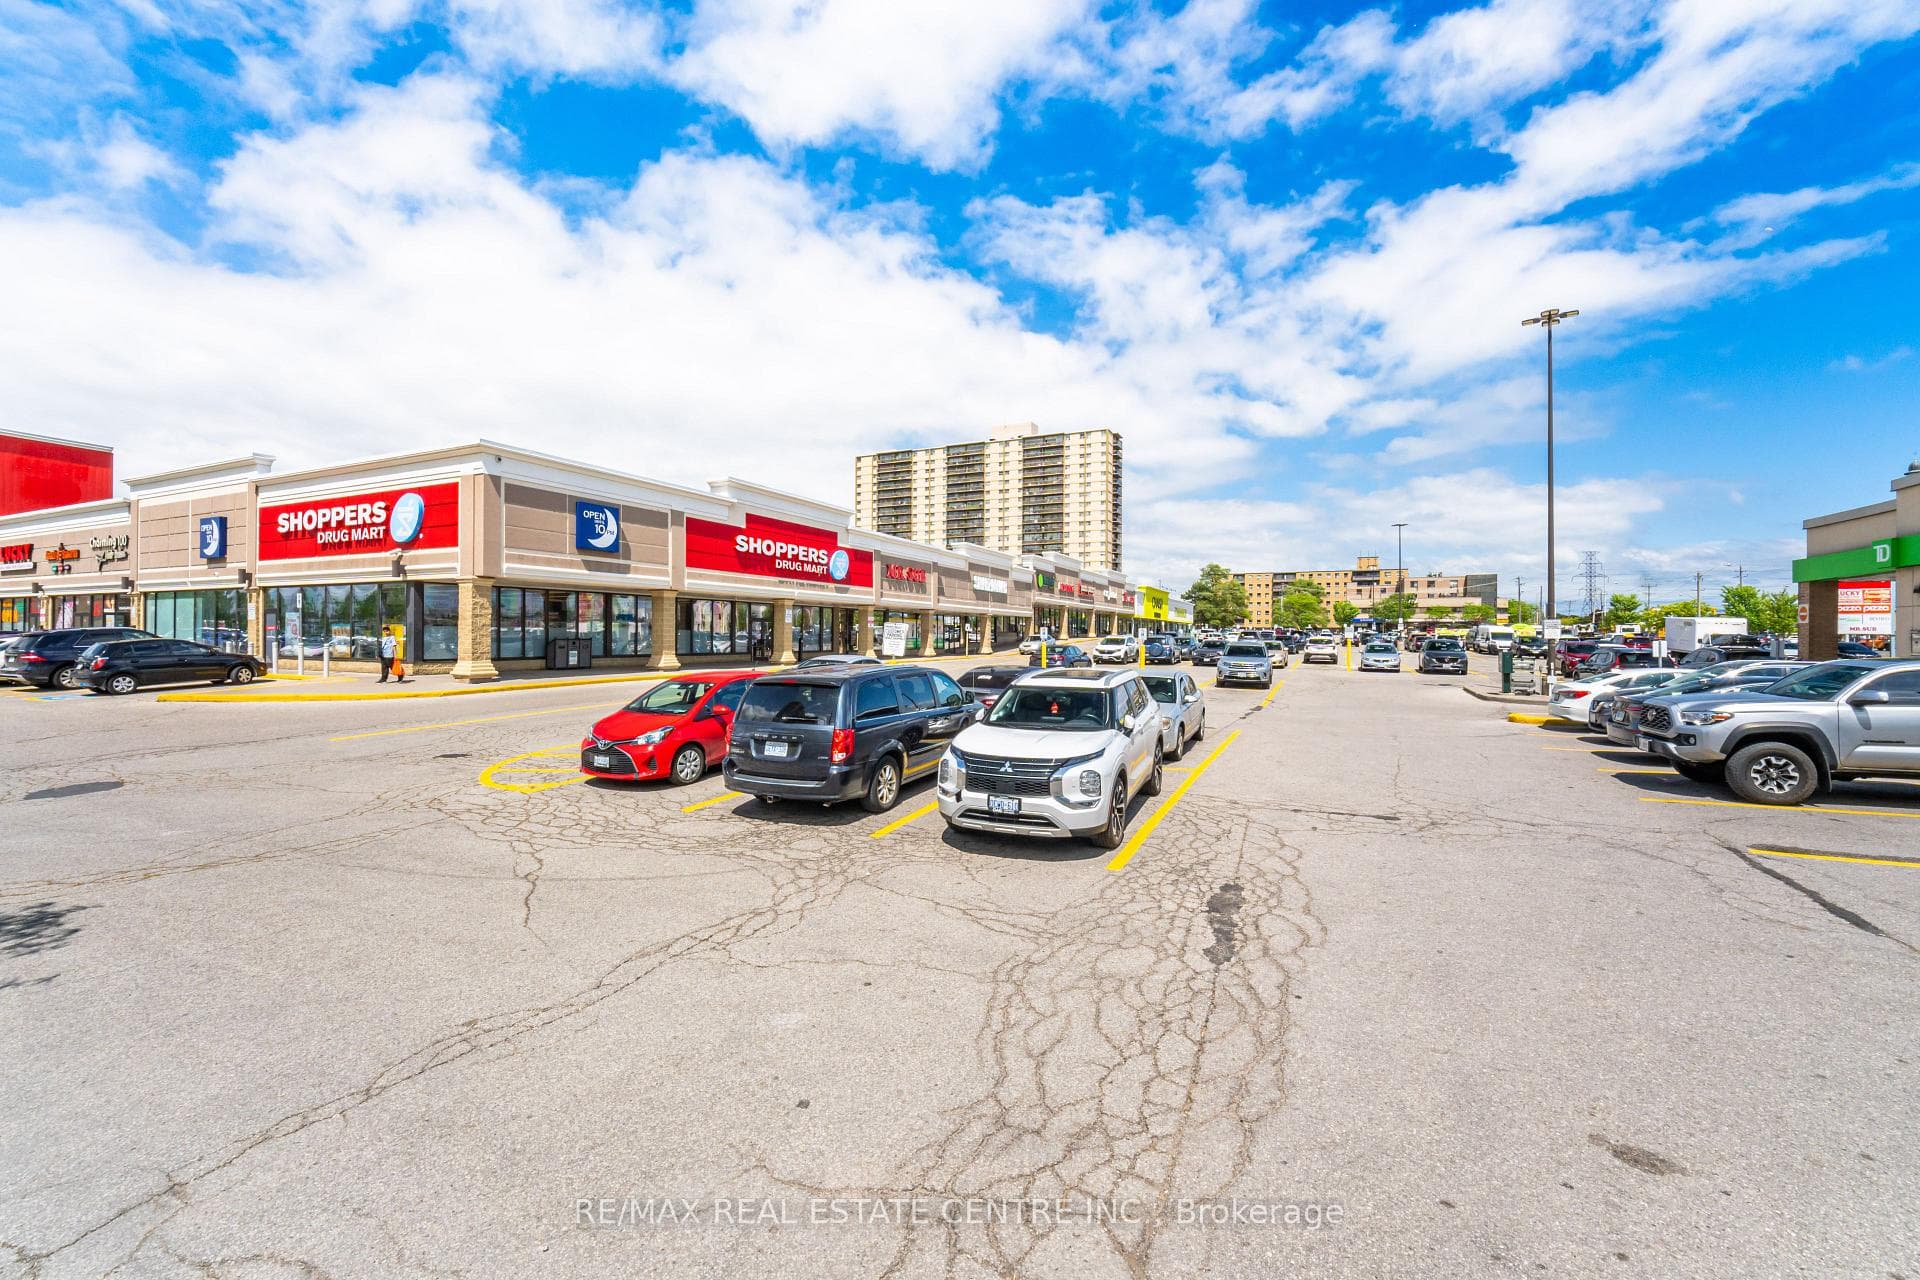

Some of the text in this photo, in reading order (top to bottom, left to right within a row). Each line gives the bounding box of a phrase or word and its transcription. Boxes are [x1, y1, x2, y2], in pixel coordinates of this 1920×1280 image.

[277, 501, 387, 533] SHOPPERS
[583, 510, 606, 521] OPEN
[316, 526, 387, 544] DRUG MART
[594, 524, 606, 534] 10
[735, 534, 828, 564] SHOPPERS
[1873, 544, 1890, 563] TD
[775, 559, 828, 575] DRUG MART
